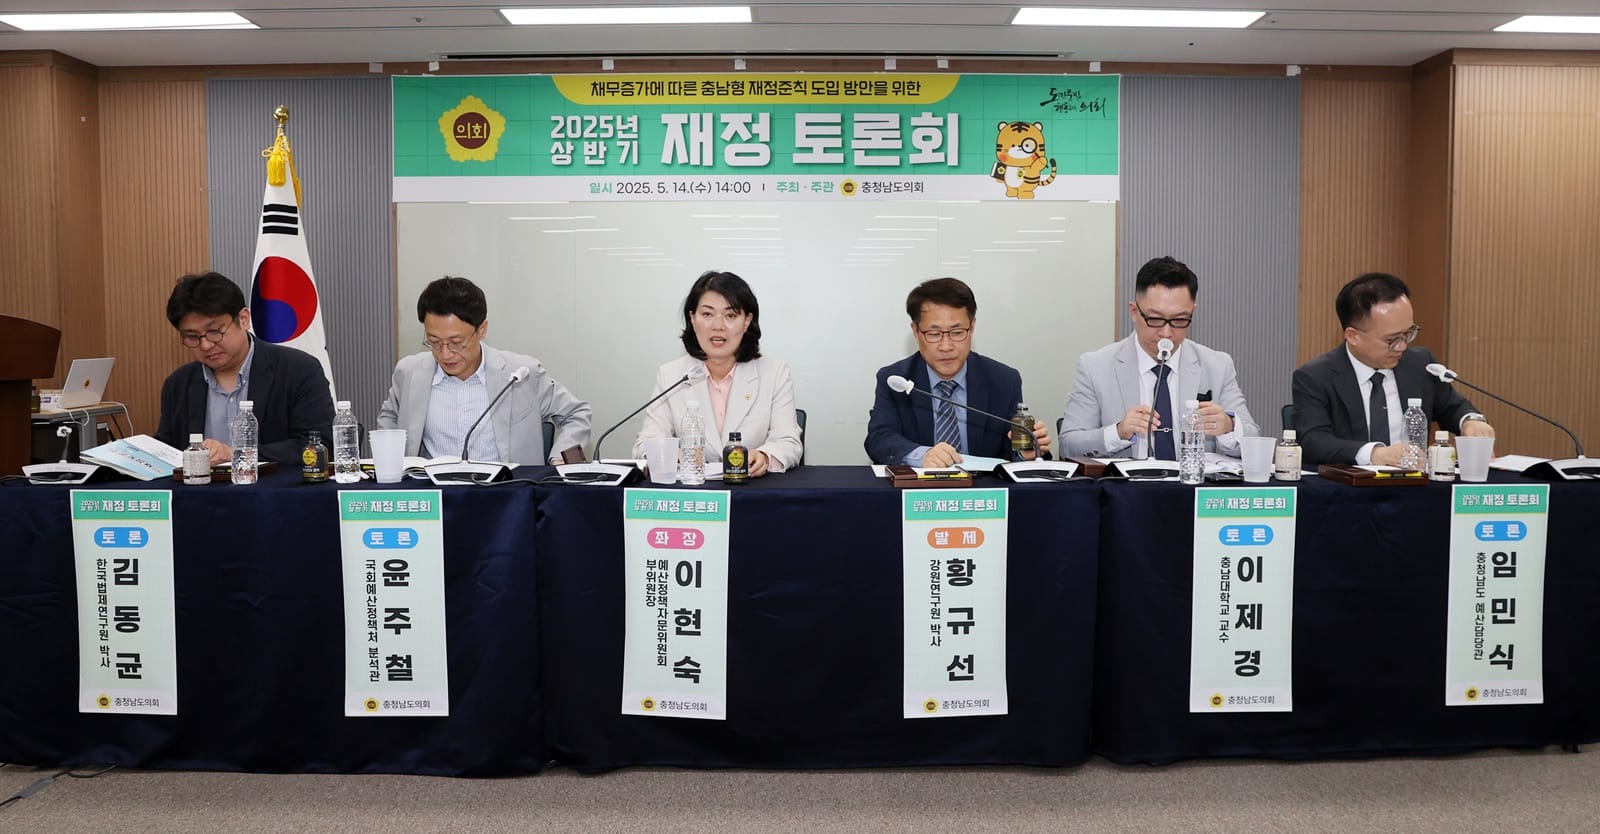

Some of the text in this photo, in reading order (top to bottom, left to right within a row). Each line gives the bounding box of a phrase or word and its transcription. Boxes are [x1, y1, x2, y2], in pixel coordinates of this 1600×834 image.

[591, 80, 921, 97] 채무증가에 따른 충남형 재정준칙 도입 방안을 위한
[455, 123, 487, 139] 의회
[550, 114, 638, 139] 2025년
[661, 111, 959, 166] 재정 토론회
[550, 140, 639, 165] 상반기
[589, 181, 751, 194] 일시 2025. 5. 14.(수) 14:00
[776, 180, 799, 193] 주최
[811, 180, 834, 193] 주관
[861, 181, 924, 194] 충청남도의회
[102, 500, 161, 512] 재정 토론회
[370, 500, 431, 512] 재정 토론회
[656, 500, 718, 513] 재정 토론회
[935, 499, 997, 512] 재정 토론회
[1227, 497, 1286, 509] 재정 토론회
[1483, 494, 1539, 506] 재정 토론회
[101, 530, 142, 545] 토론
[370, 531, 412, 545] 토론
[654, 531, 697, 546] 좌장
[934, 530, 977, 545] 발제
[1225, 528, 1267, 542] 토론
[1481, 524, 1520, 538] 토론
[645, 559, 657, 607] 부위원장
[929, 559, 942, 647] 강원연구원 박사
[1218, 556, 1231, 643] 충남대학교 교수
[1474, 552, 1486, 661] 충청남도 예산담당관
[96, 559, 111, 668] 한국법제연구원 박사
[657, 559, 669, 667] 예산정책자문위원회
[1234, 556, 1263, 677] 이제경
[1488, 551, 1517, 670] 임민식
[113, 558, 142, 680] 김동균
[365, 560, 380, 682] 국회예산정책처 분석관
[382, 558, 413, 681] 윤주철
[673, 560, 702, 684] 이현숙
[946, 558, 976, 681] 황규선
[1228, 695, 1275, 705] 충청남도의회
[1482, 688, 1527, 698] 충청남도의회
[114, 697, 160, 707] 충청남도의회
[382, 700, 431, 709] 충청남도의회
[660, 700, 708, 711] 충청남도의회
[942, 699, 990, 710] 충청남도의회
